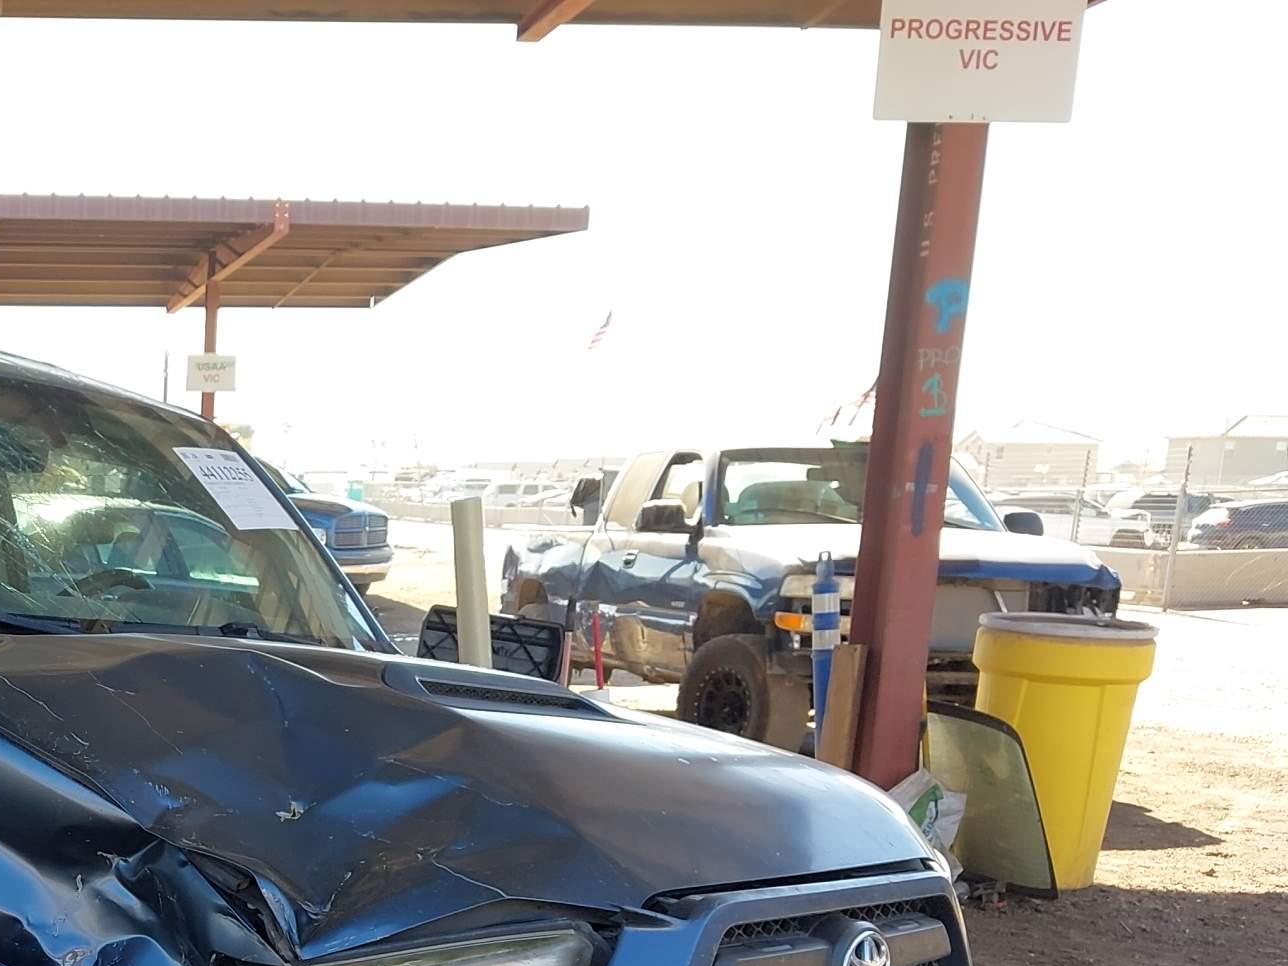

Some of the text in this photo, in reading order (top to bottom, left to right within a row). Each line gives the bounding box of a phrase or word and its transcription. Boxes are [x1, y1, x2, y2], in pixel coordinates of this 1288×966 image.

[889, 18, 1073, 42] PROGRESSIVE
[959, 49, 1000, 70] VIC
[202, 374, 221, 384] VIC
[199, 465, 254, 481] 44112255
